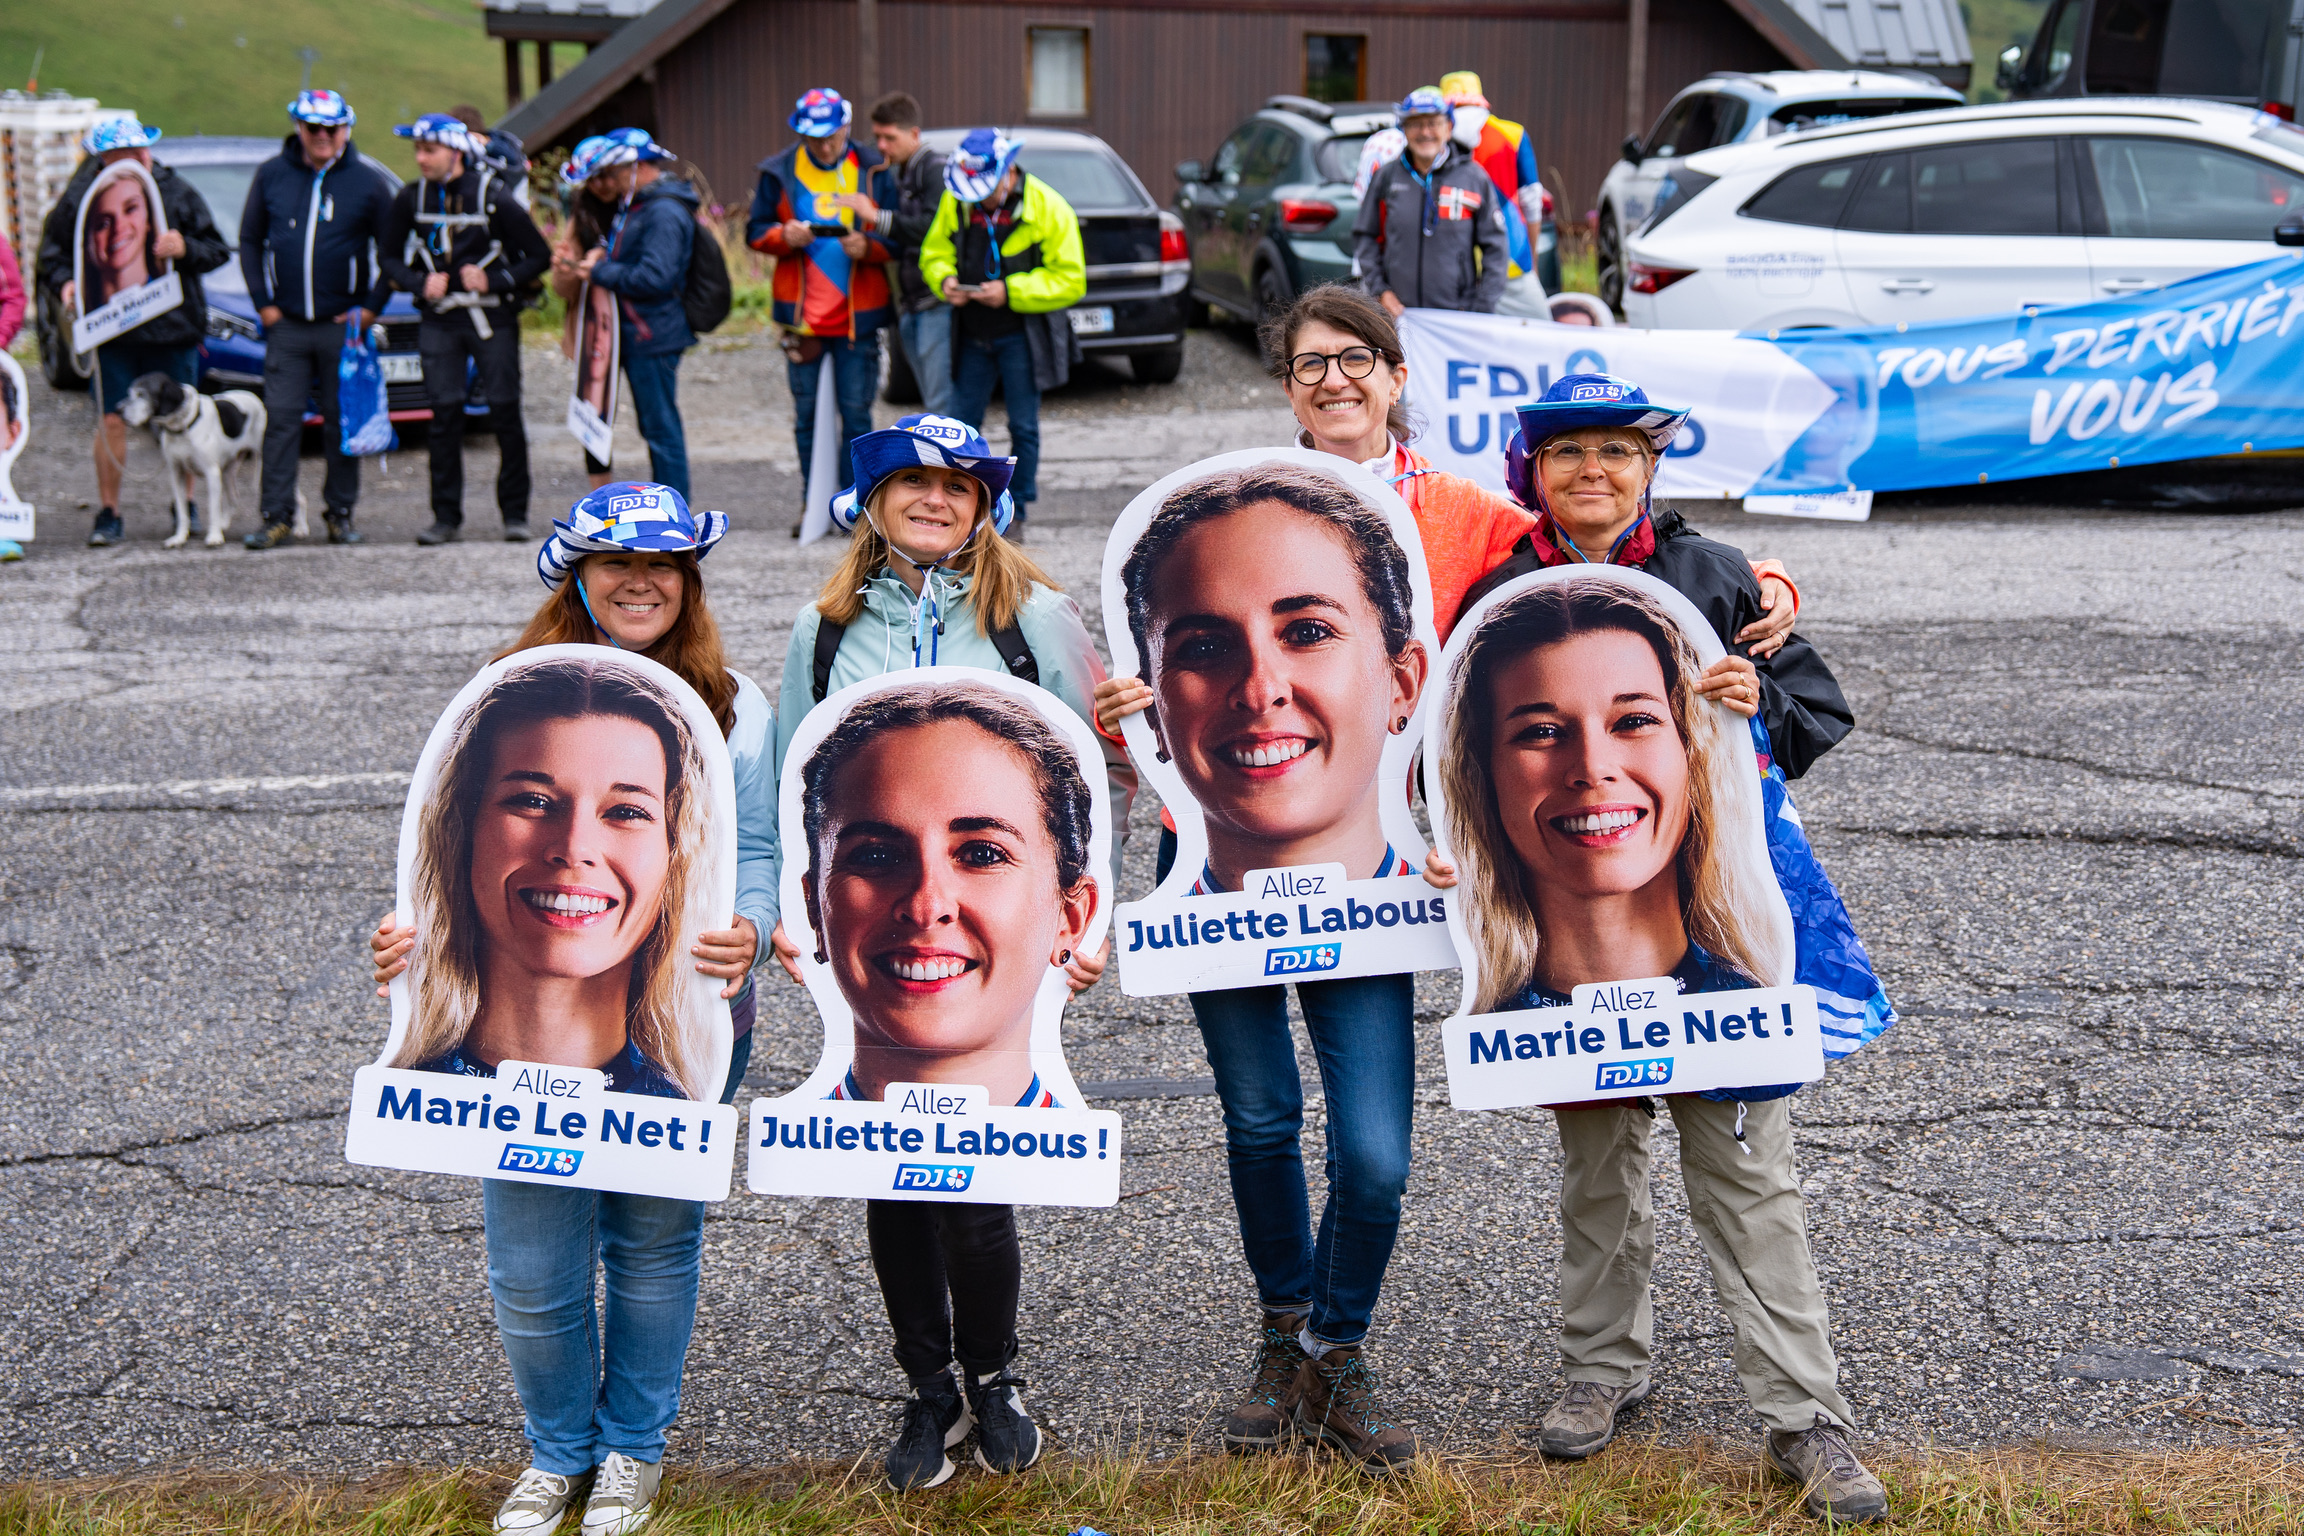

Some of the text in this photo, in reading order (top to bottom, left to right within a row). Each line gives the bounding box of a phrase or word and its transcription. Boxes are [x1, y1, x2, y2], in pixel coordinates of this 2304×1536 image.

[1877, 339, 2028, 388] TOUS
[1575, 386, 1604, 400] FDJ
[2030, 360, 2219, 445] VOUS
[612, 497, 642, 512] FDJ
[1262, 872, 1326, 899] Allez
[1128, 897, 1447, 951] Juliette Labous
[1269, 950, 1312, 971] FDJ
[1591, 986, 1657, 1013] Allez
[1469, 1003, 1794, 1064] Marie Le Net !
[512, 1069, 581, 1098] Allez
[1600, 1063, 1643, 1085] FDJ
[900, 1089, 966, 1115] Allez
[376, 1085, 712, 1153] Marie Le Net !
[760, 1116, 1108, 1160] Juliette Labous !
[503, 1147, 552, 1170] FDJ
[898, 1166, 943, 1188] FDJ
